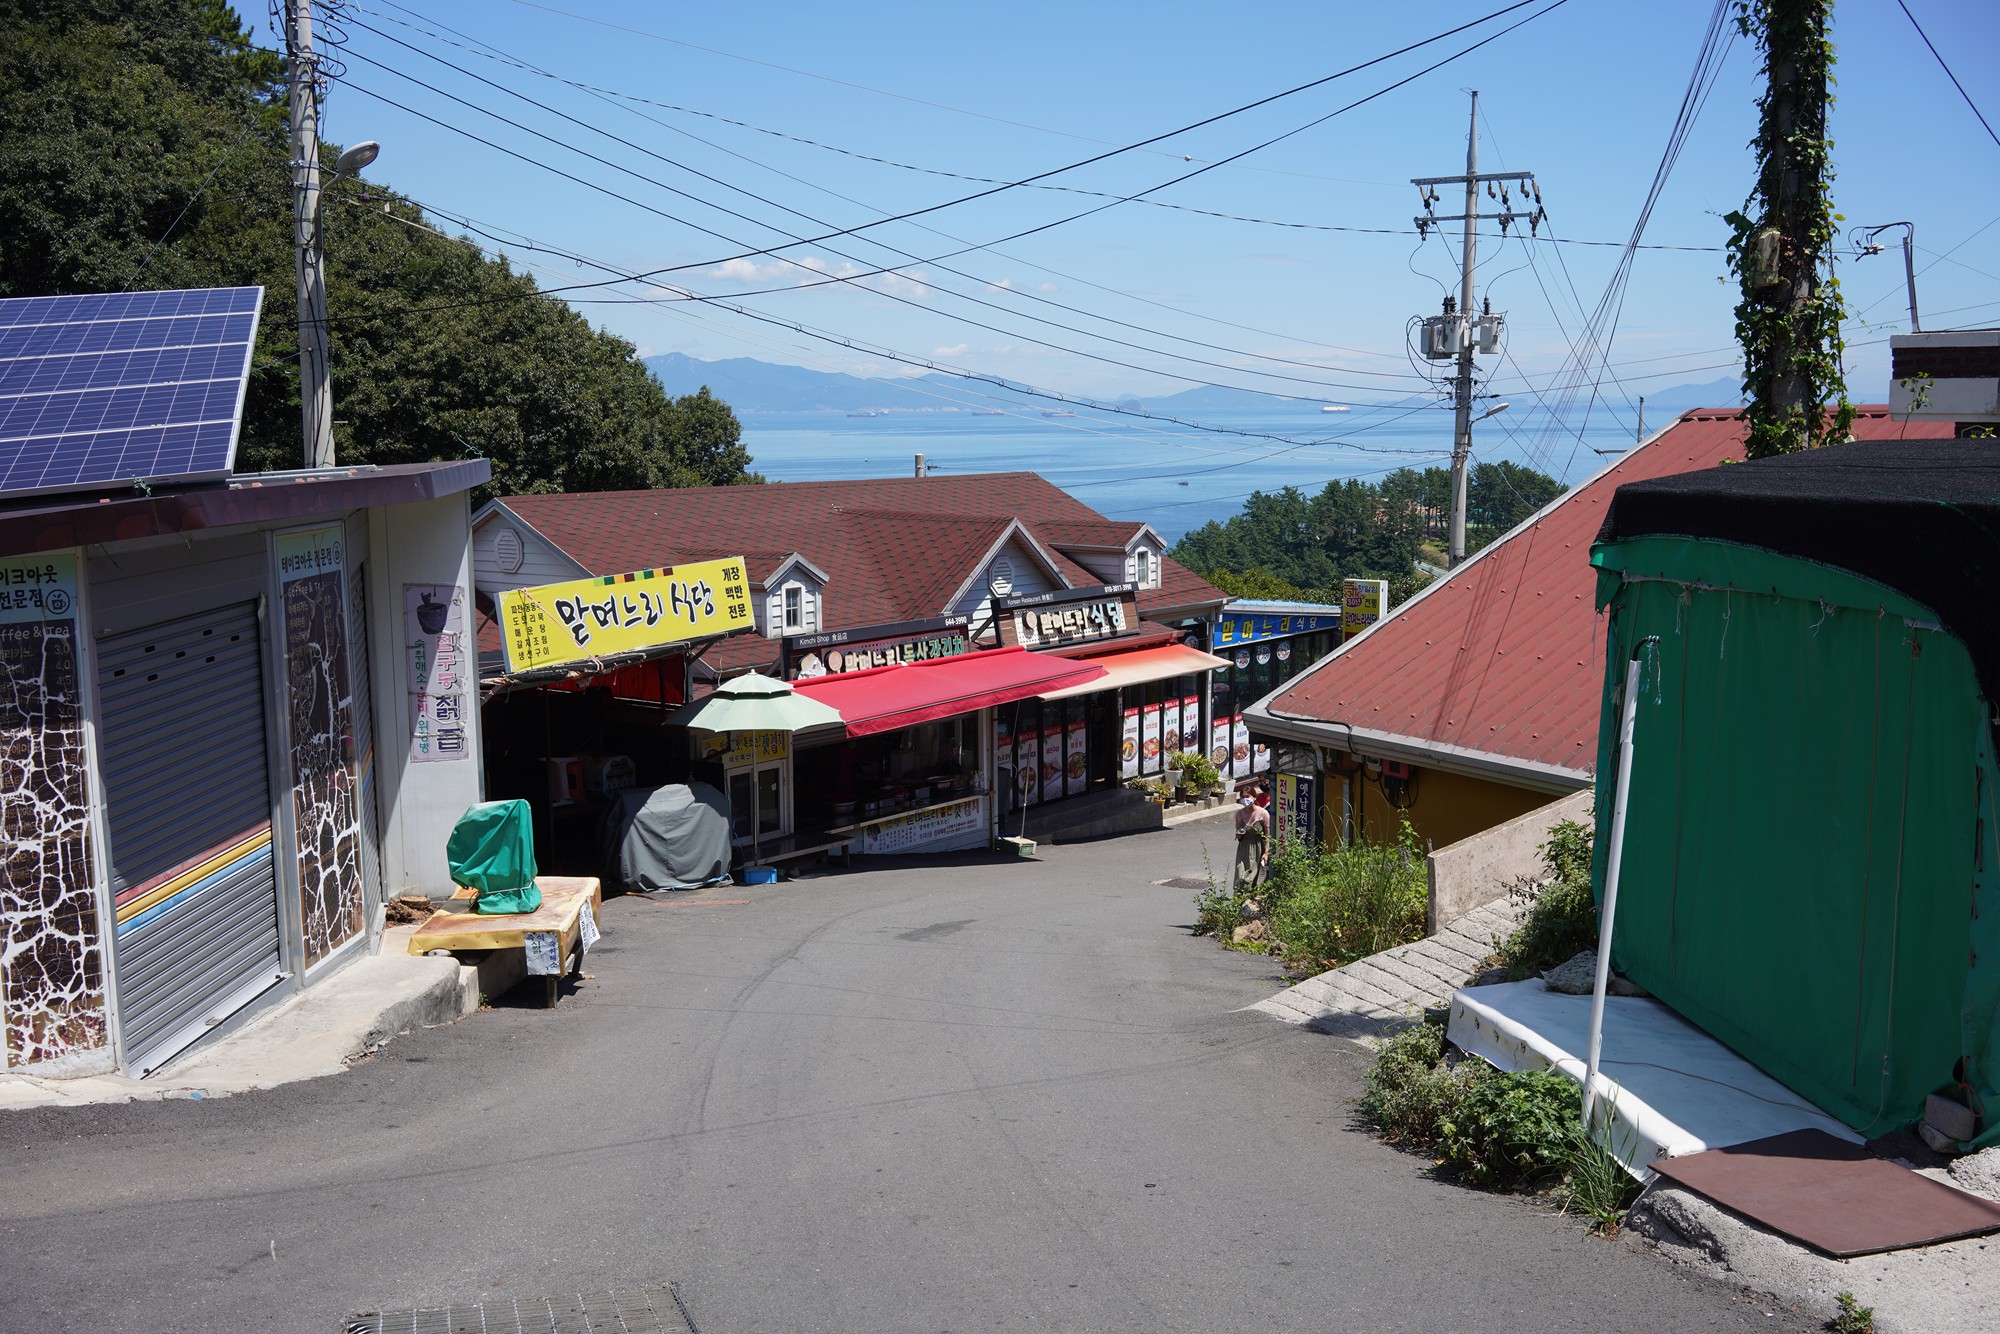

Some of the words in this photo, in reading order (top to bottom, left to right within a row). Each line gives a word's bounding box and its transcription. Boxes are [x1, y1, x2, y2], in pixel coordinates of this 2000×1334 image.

[281, 551, 313, 574] 테이크아웃
[722, 566, 740, 582] 게장
[725, 584, 743, 600] 백반
[670, 580, 714, 624] 식당
[1021, 596, 1041, 604] Restaurant
[728, 603, 746, 619] 전문
[1091, 601, 1121, 628] 식당
[945, 615, 968, 627] 644-3990
[1296, 616, 1318, 630] 식당
[33, 625, 42, 638] &
[800, 637, 816, 646] Kimchi
[816, 634, 829, 644] Shop
[54, 644, 70, 656] 3.0
[56, 659, 71, 671] 4.0
